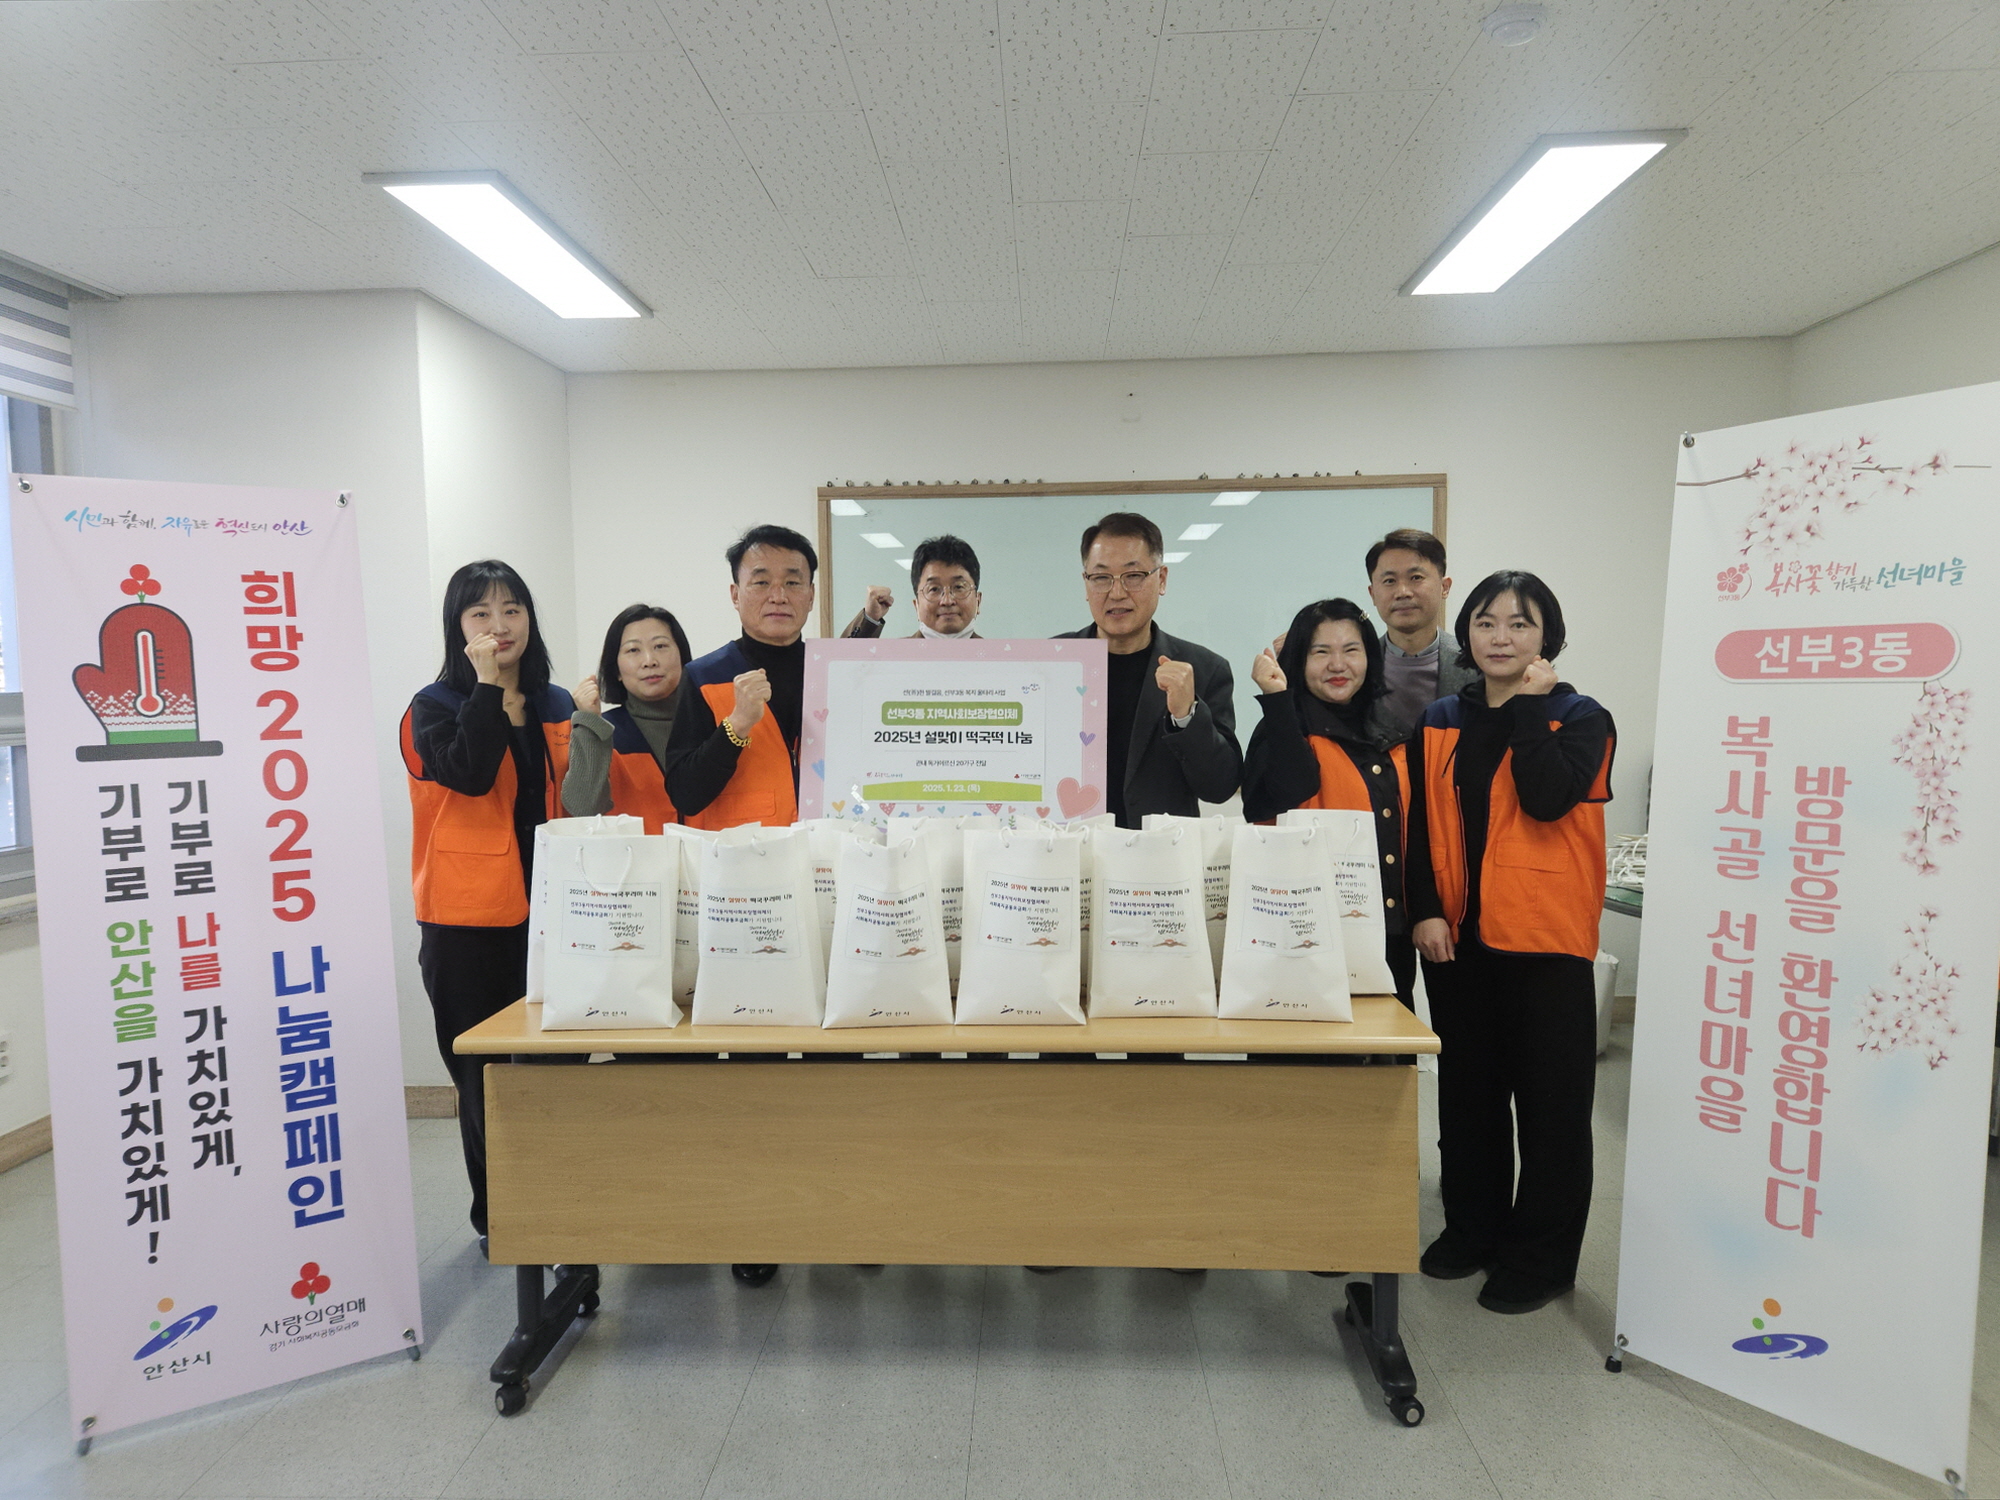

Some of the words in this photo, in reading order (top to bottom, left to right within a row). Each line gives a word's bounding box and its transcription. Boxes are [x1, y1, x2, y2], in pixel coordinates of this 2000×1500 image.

[64, 507, 118, 533] 시민과
[272, 519, 313, 536] 안산
[1825, 561, 1857, 582] 향기
[1833, 576, 1874, 592] 가득한
[1876, 557, 1967, 589] 선녀마을
[1754, 630, 1912, 674] 선부3동
[874, 731, 921, 744] 2025년
[925, 730, 962, 744] 설맞이
[965, 730, 1004, 744] 떡국떡
[1007, 730, 1033, 744] 나눔
[886, 707, 926, 720] 선부3동
[927, 707, 1018, 720] 지역사회보장협의체
[99, 783, 149, 903] 기부로
[167, 780, 217, 897] 기부로
[1712, 715, 1774, 880] 복사골
[1784, 765, 1853, 935] 방문을
[106, 919, 158, 1043] 안산을
[177, 912, 222, 992] 나를
[1694, 909, 1758, 1134] 선녀마을
[183, 1005, 242, 1177] 가치있게,
[272, 945, 345, 1229] 나눔캠페인
[1764, 952, 1839, 1239] 환영합니다
[117, 1057, 171, 1265] 가치있게!
[143, 1351, 211, 1381] 안산시
[259, 1297, 366, 1337] 사랑의열매
